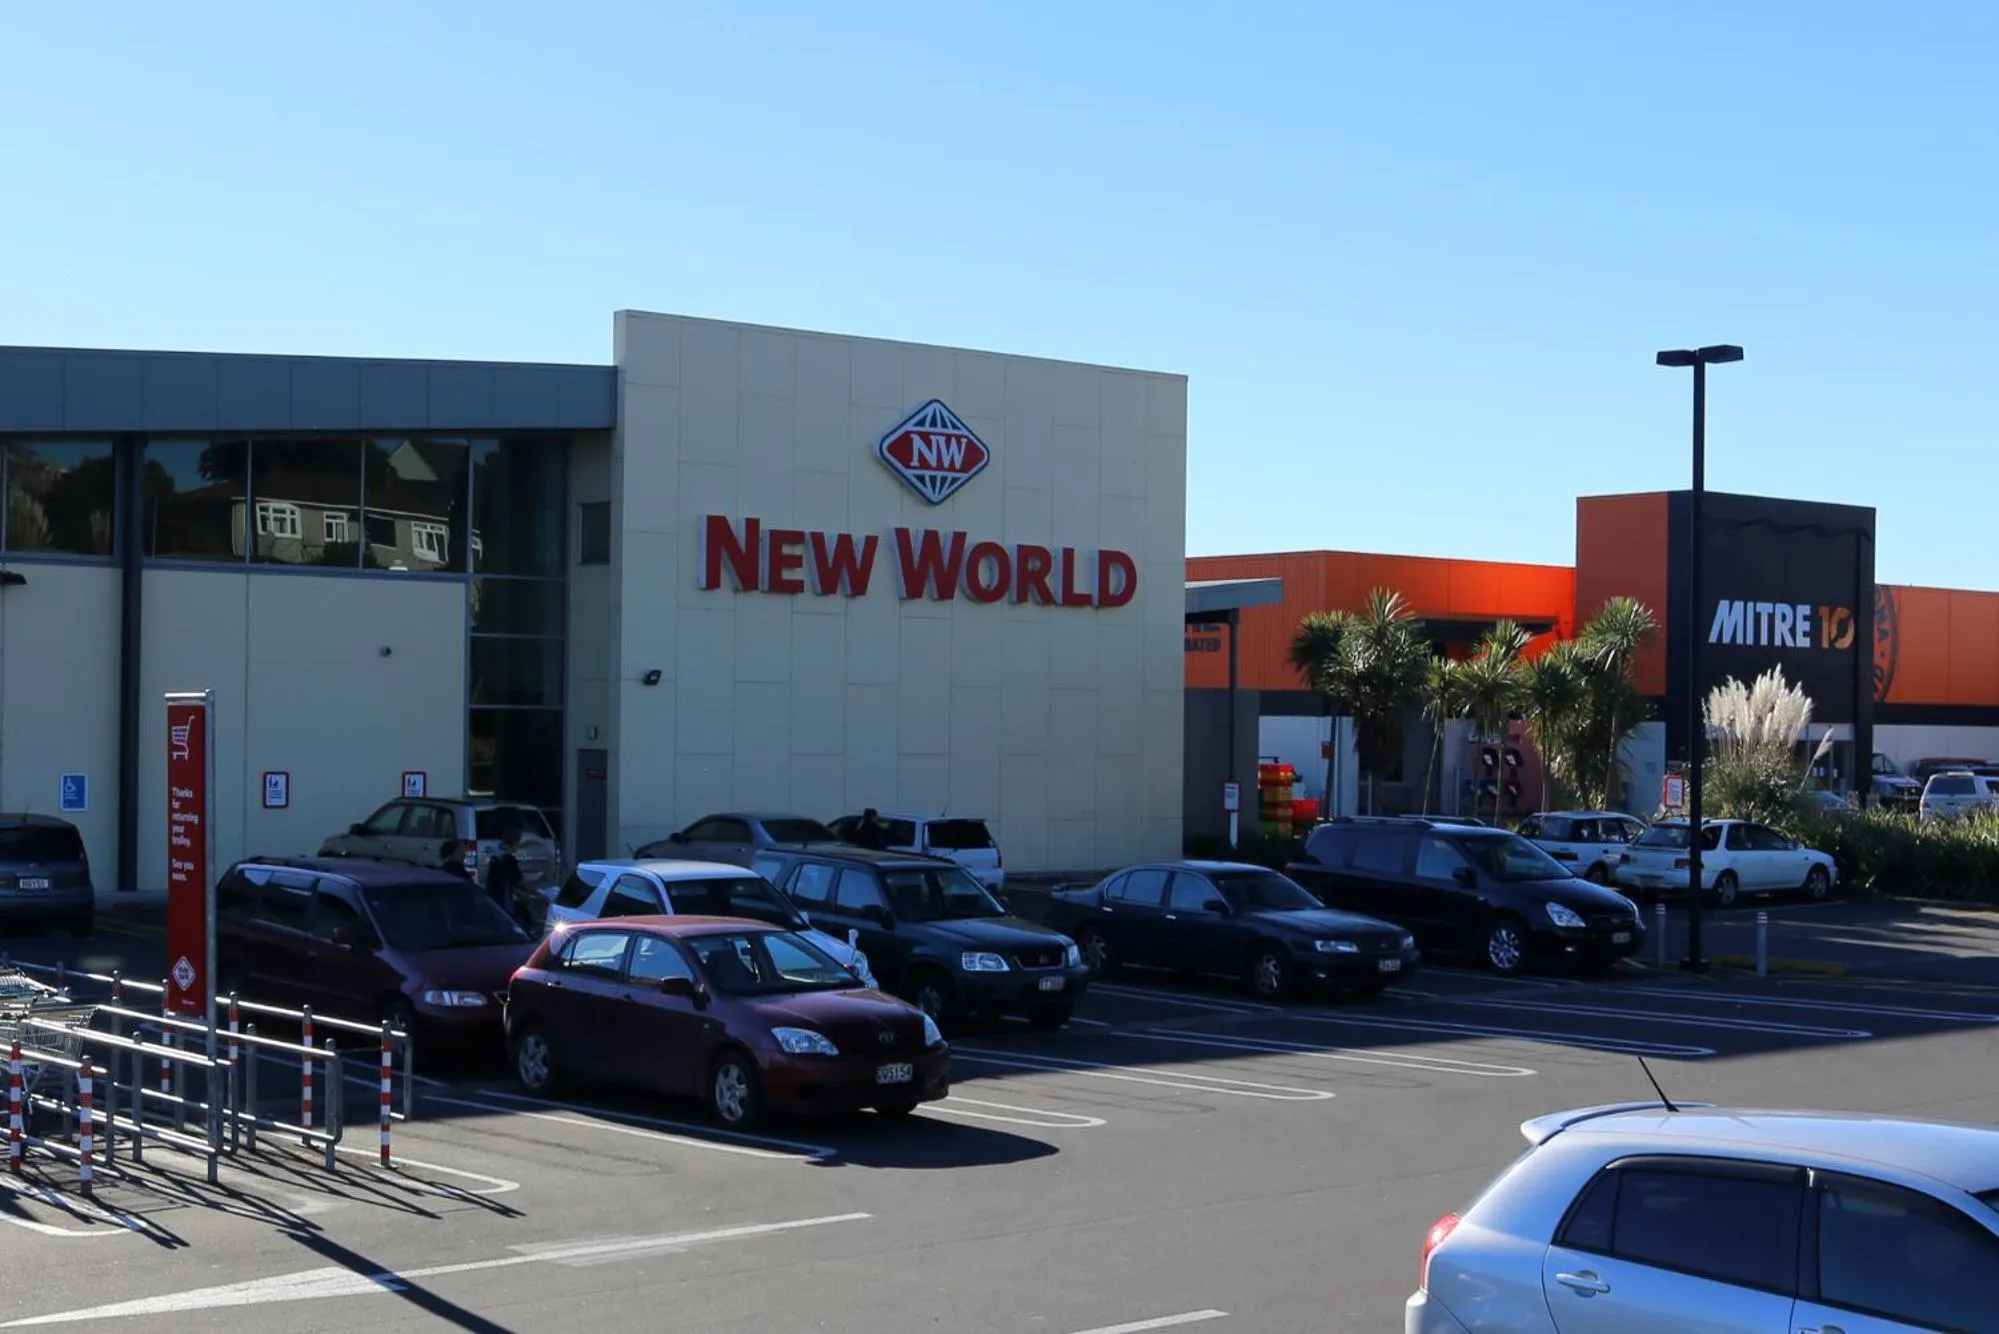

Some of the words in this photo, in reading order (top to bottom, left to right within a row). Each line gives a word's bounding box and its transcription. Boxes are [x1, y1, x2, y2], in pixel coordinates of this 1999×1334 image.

[909, 433, 968, 471] NW
[699, 515, 879, 598] NEW
[891, 527, 1138, 608] WORLD
[1708, 599, 1811, 648] MITRE
[1818, 605, 1855, 650] 10
[172, 812, 199, 825] returning
